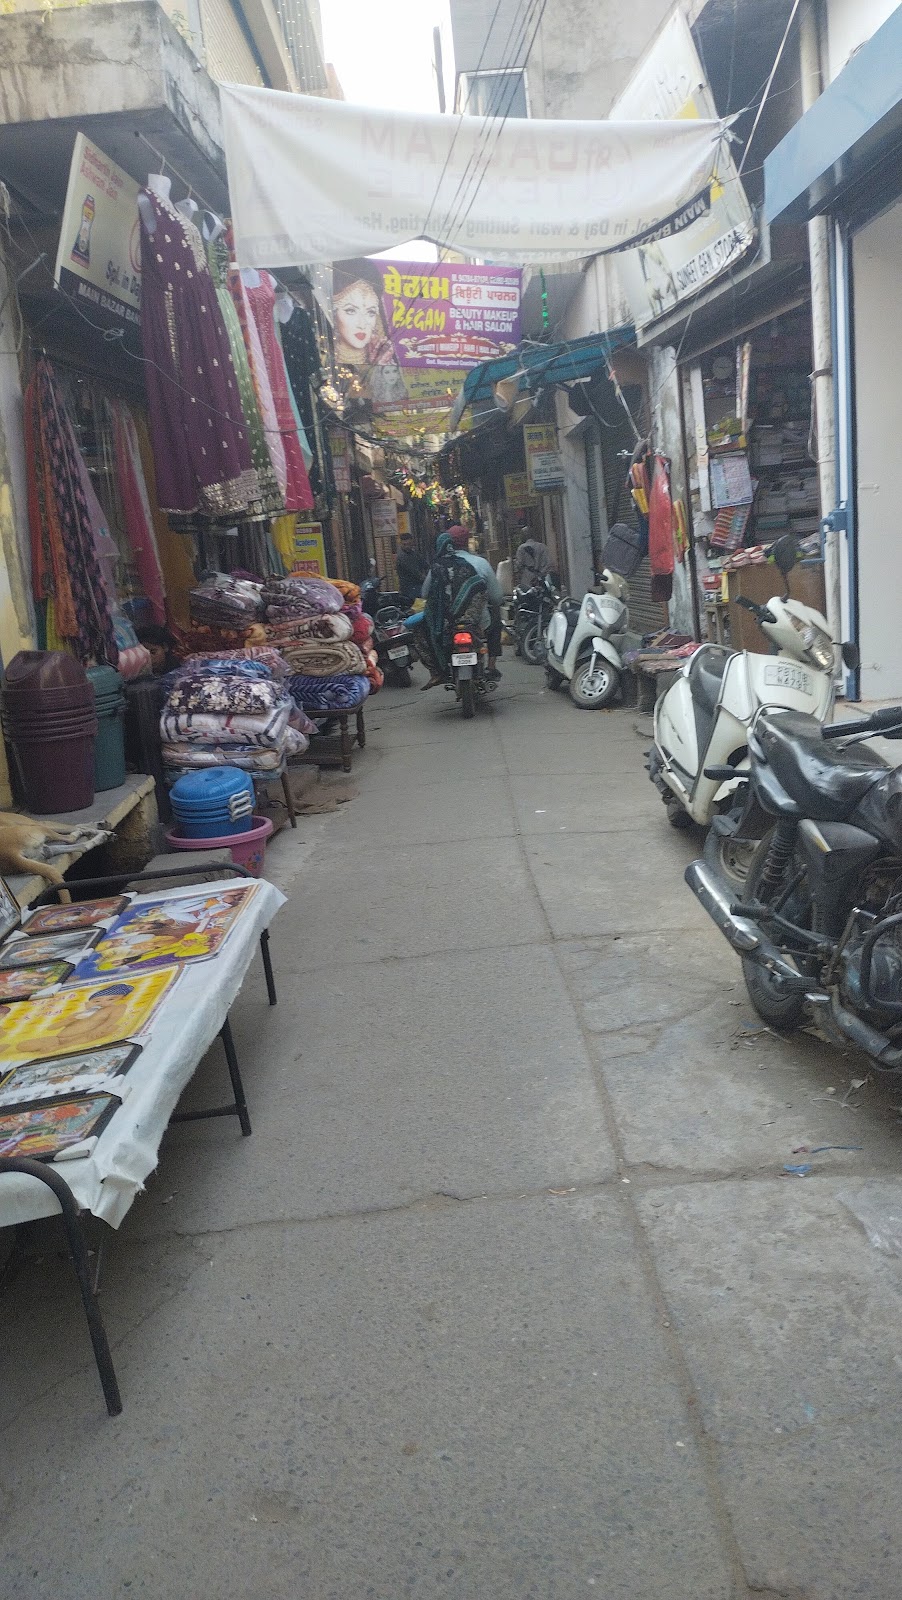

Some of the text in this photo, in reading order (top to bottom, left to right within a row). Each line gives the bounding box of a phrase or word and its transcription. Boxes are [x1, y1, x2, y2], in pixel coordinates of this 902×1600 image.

[675, 198, 706, 230] MAIN
[392, 299, 446, 332] BEGAM
[450, 308, 518, 321] BEAUTY MAKEUP
[455, 320, 513, 332] & HAIR SALON
